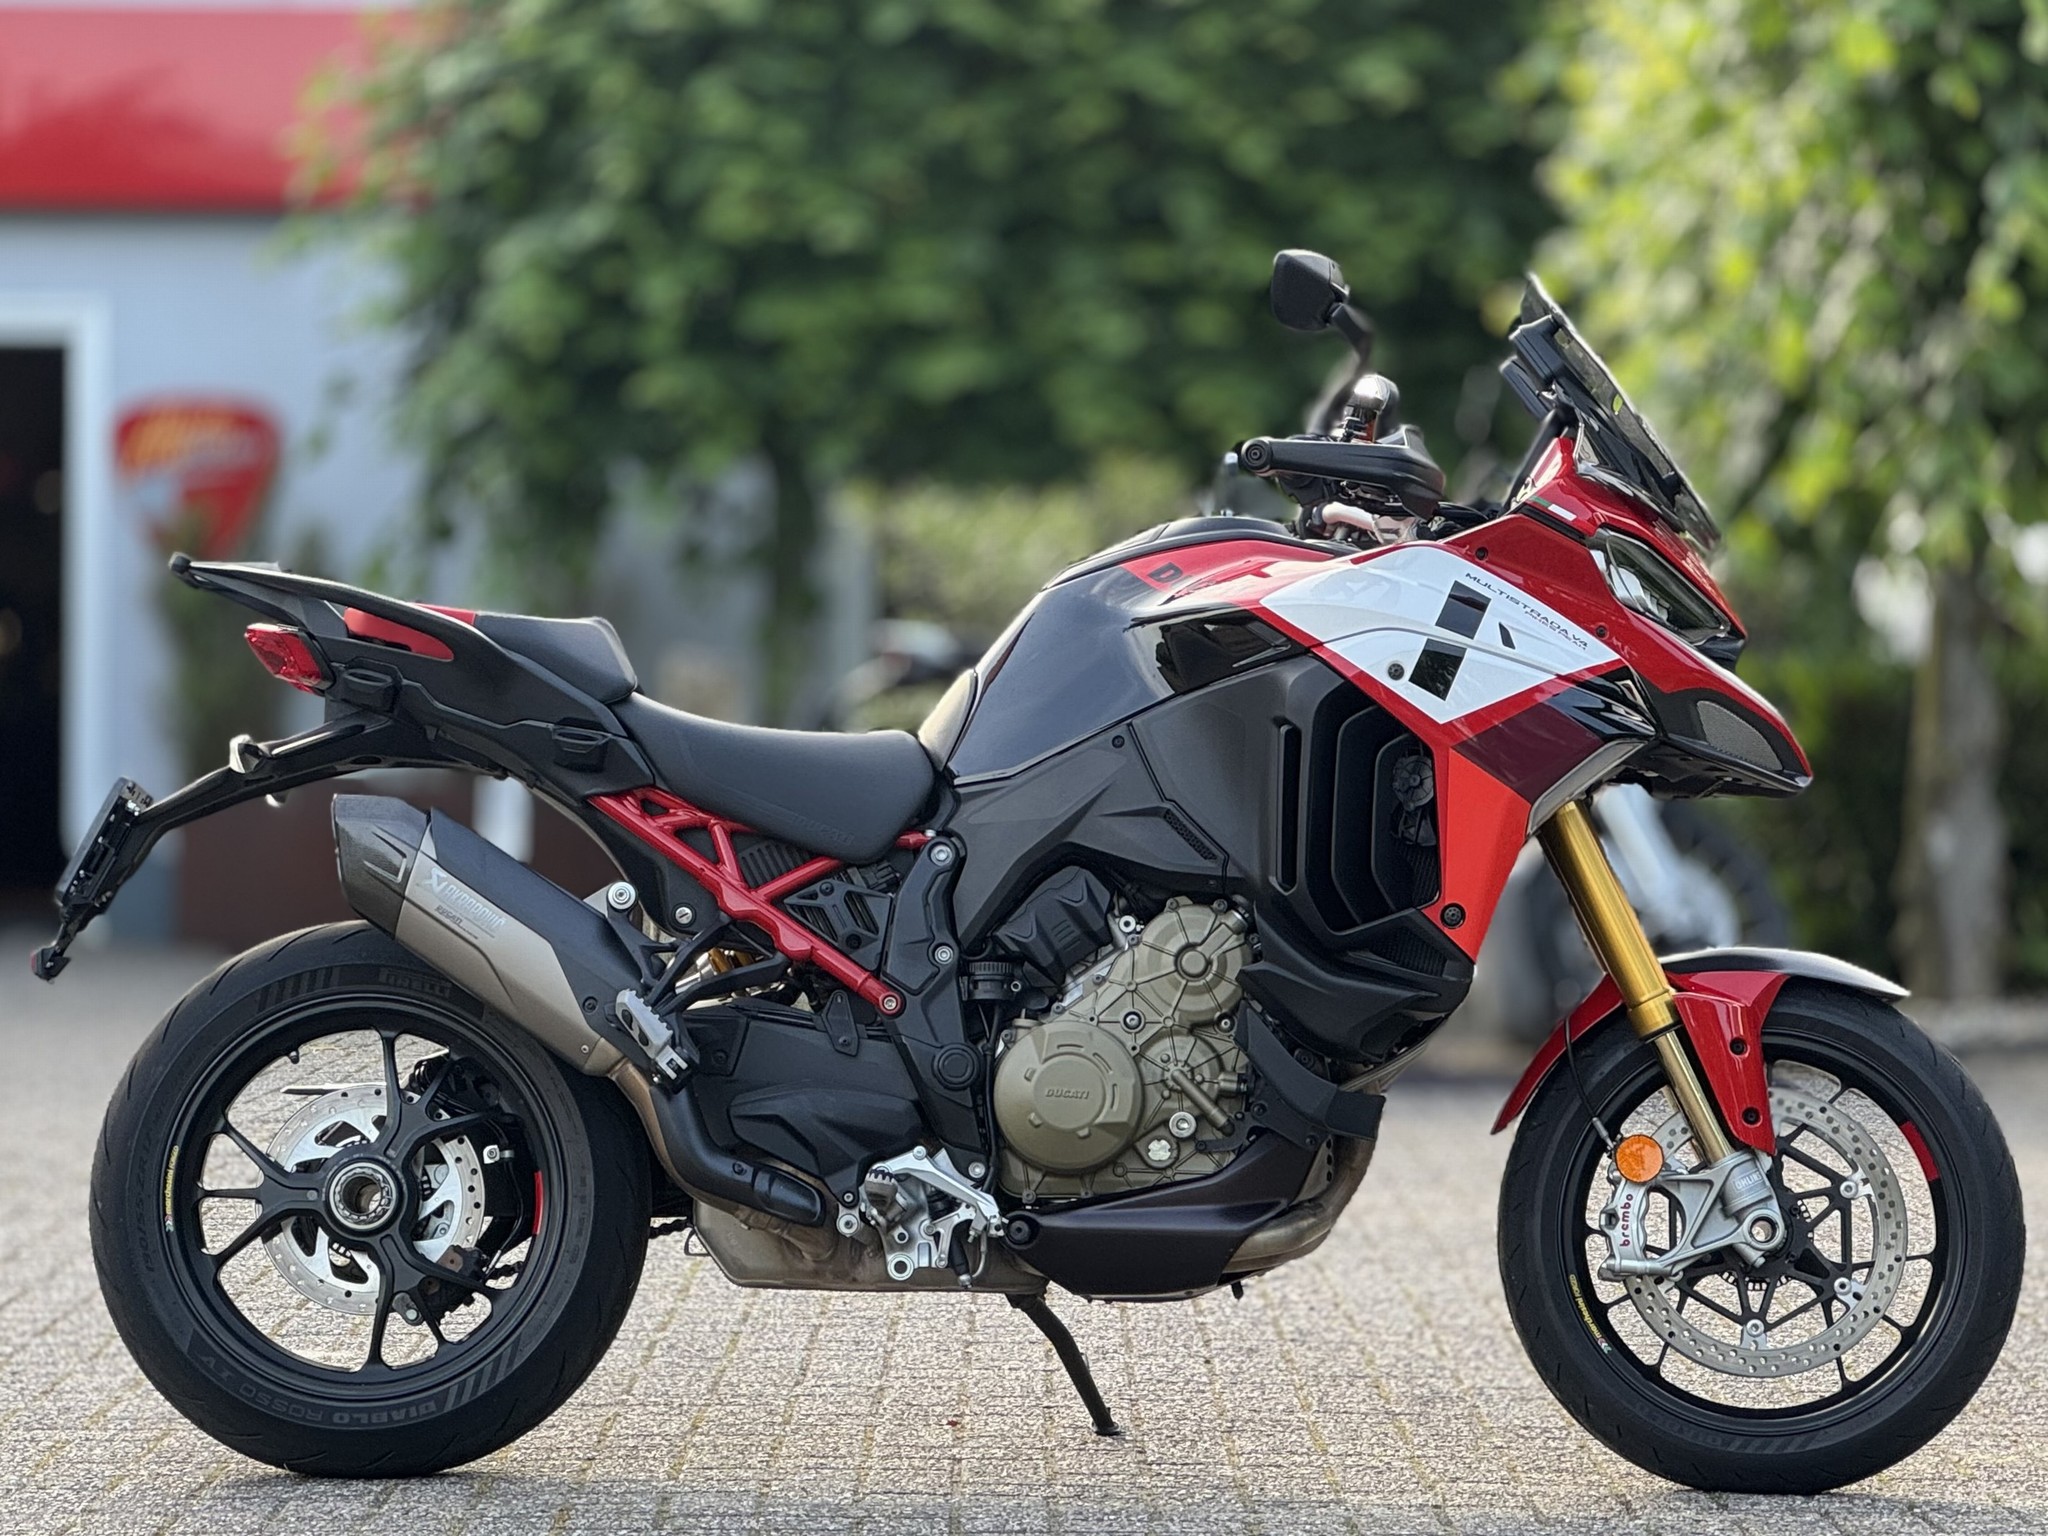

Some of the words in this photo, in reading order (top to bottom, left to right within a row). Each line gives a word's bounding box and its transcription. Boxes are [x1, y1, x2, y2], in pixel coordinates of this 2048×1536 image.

[1465, 572, 1569, 637] MULTISTRADA
[1572, 633, 1589, 648] V4
[1045, 1088, 1090, 1100] DUCATI
[1619, 1193, 1634, 1247] brembo
[239, 1383, 325, 1422] ROSSO
[331, 1400, 437, 1424] DIABLO
